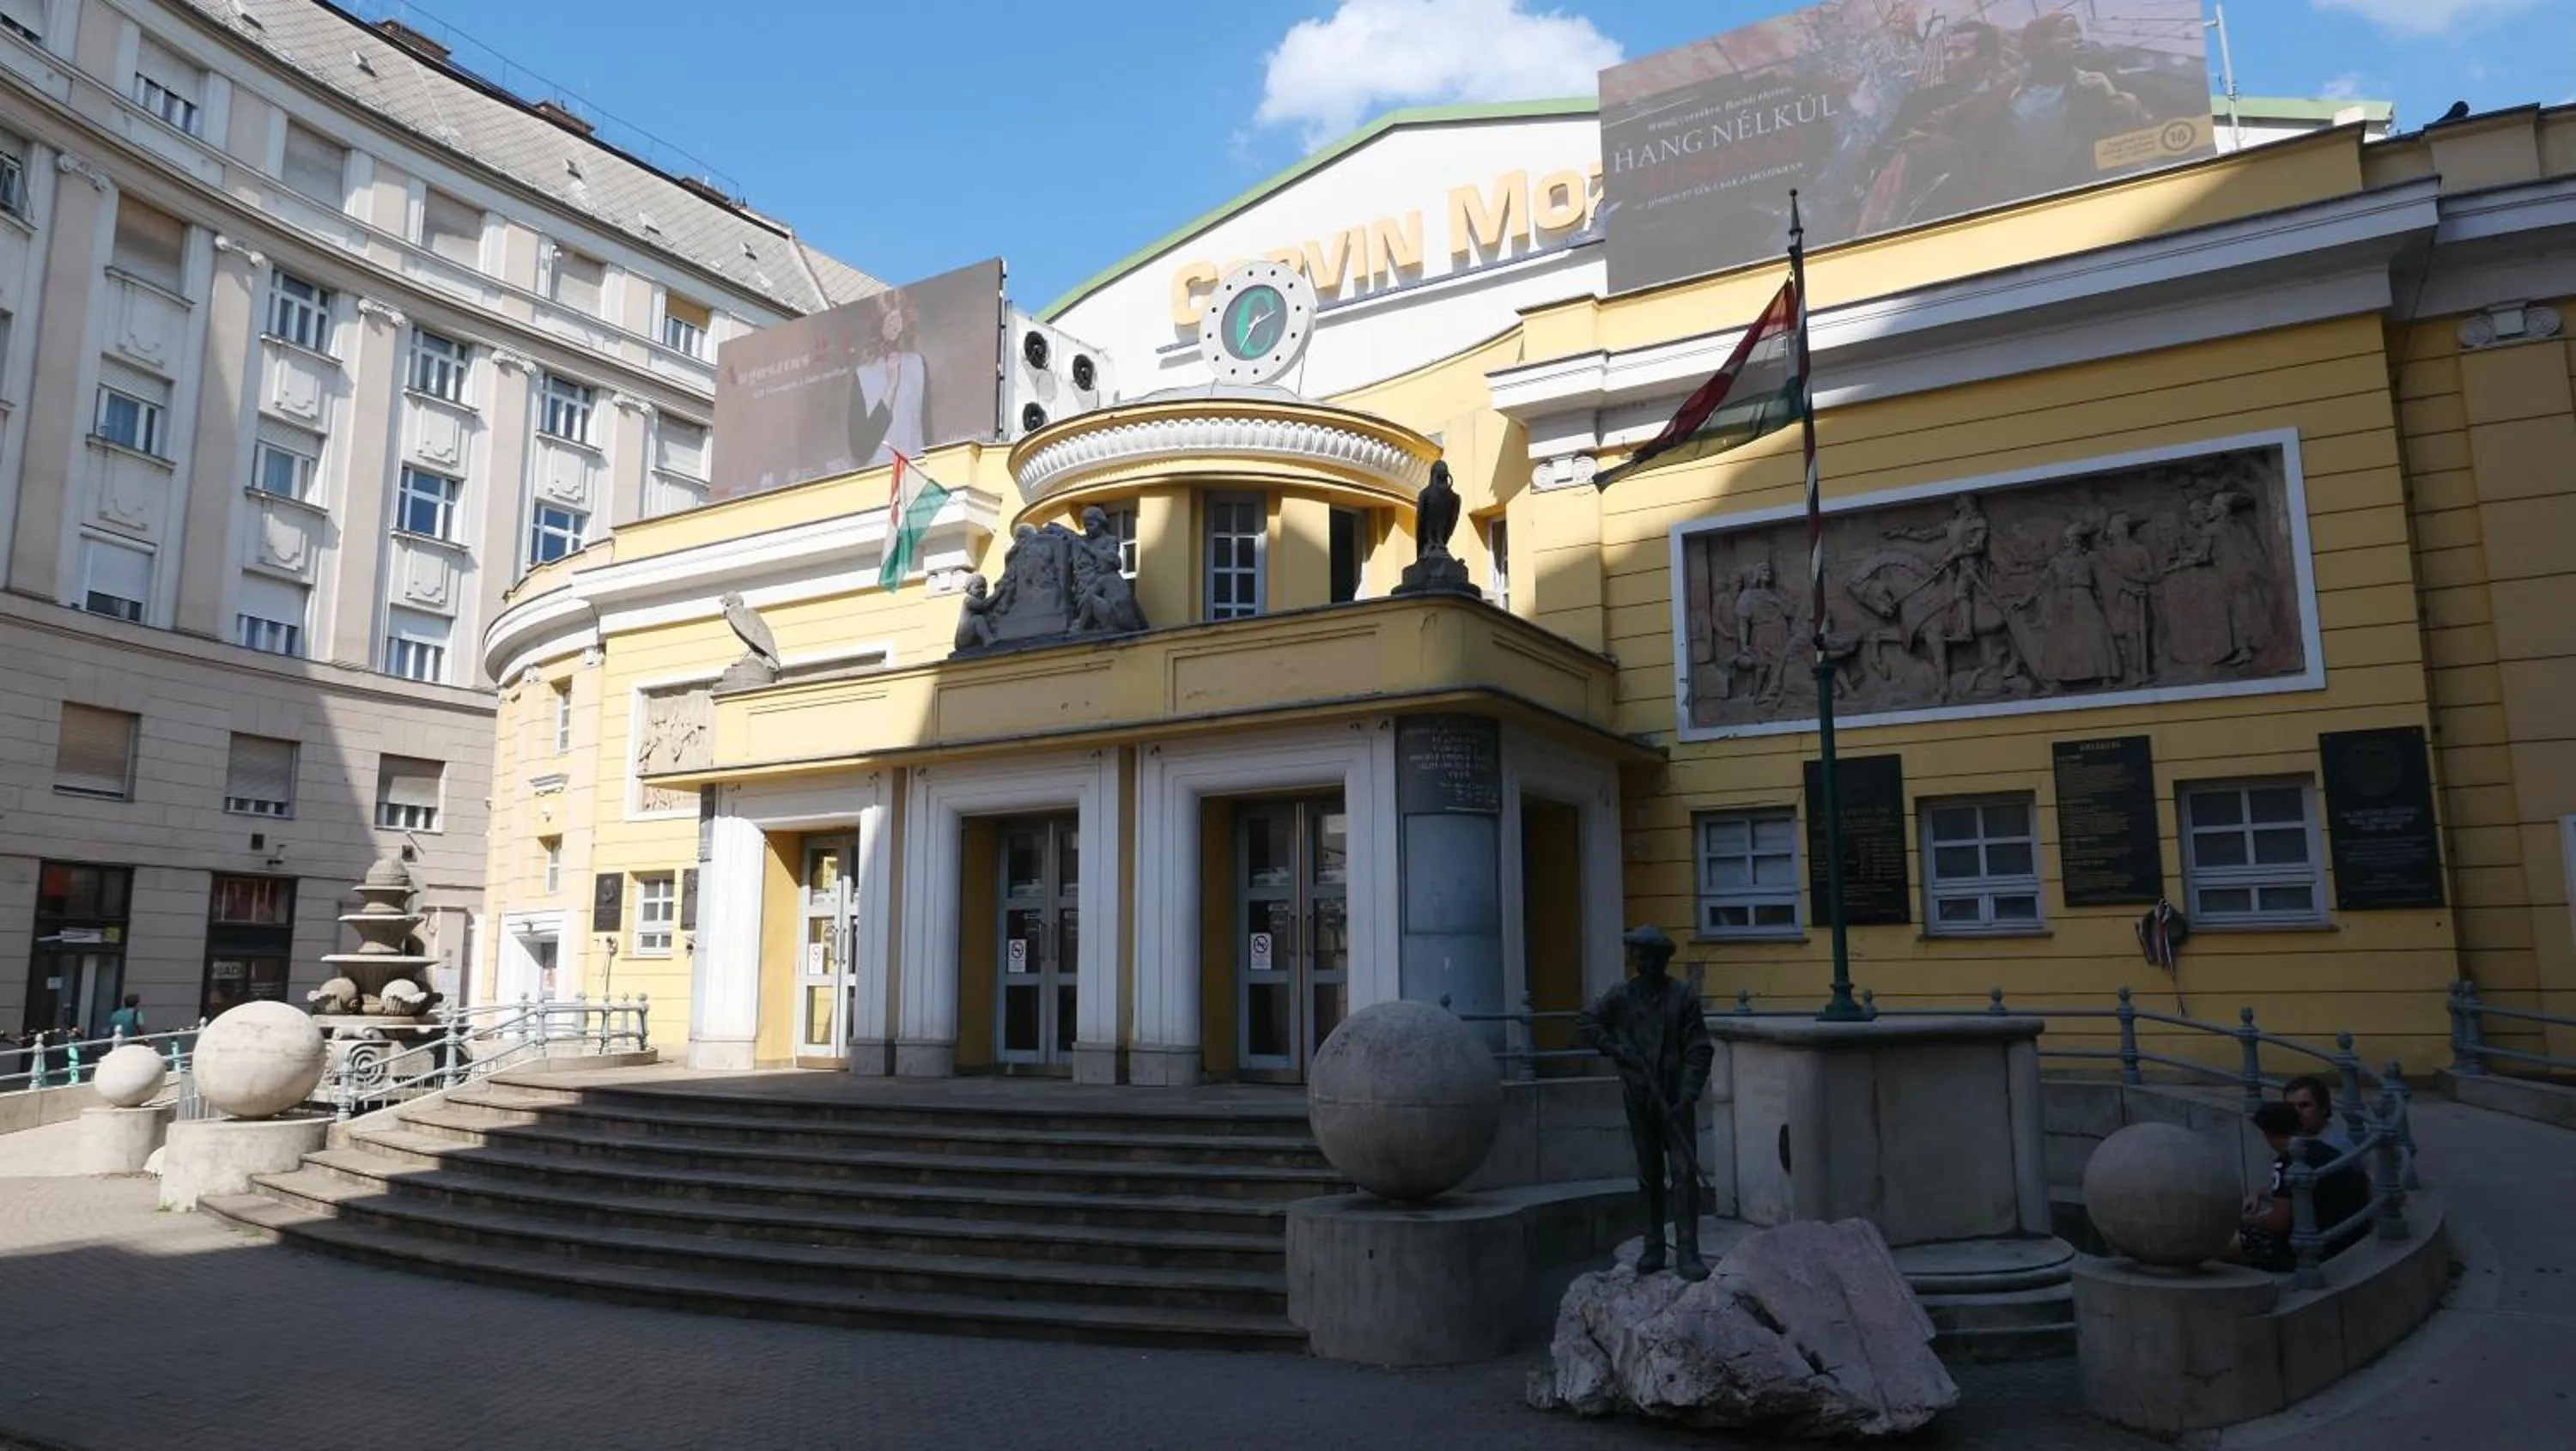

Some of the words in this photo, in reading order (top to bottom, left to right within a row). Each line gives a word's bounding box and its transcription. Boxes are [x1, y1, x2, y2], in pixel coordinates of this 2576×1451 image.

[1614, 129, 1704, 173] HANG
[1711, 92, 1839, 149] NÉLKÜL
[2169, 128, 2188, 143] 16
[1170, 209, 1423, 326] CVIN
